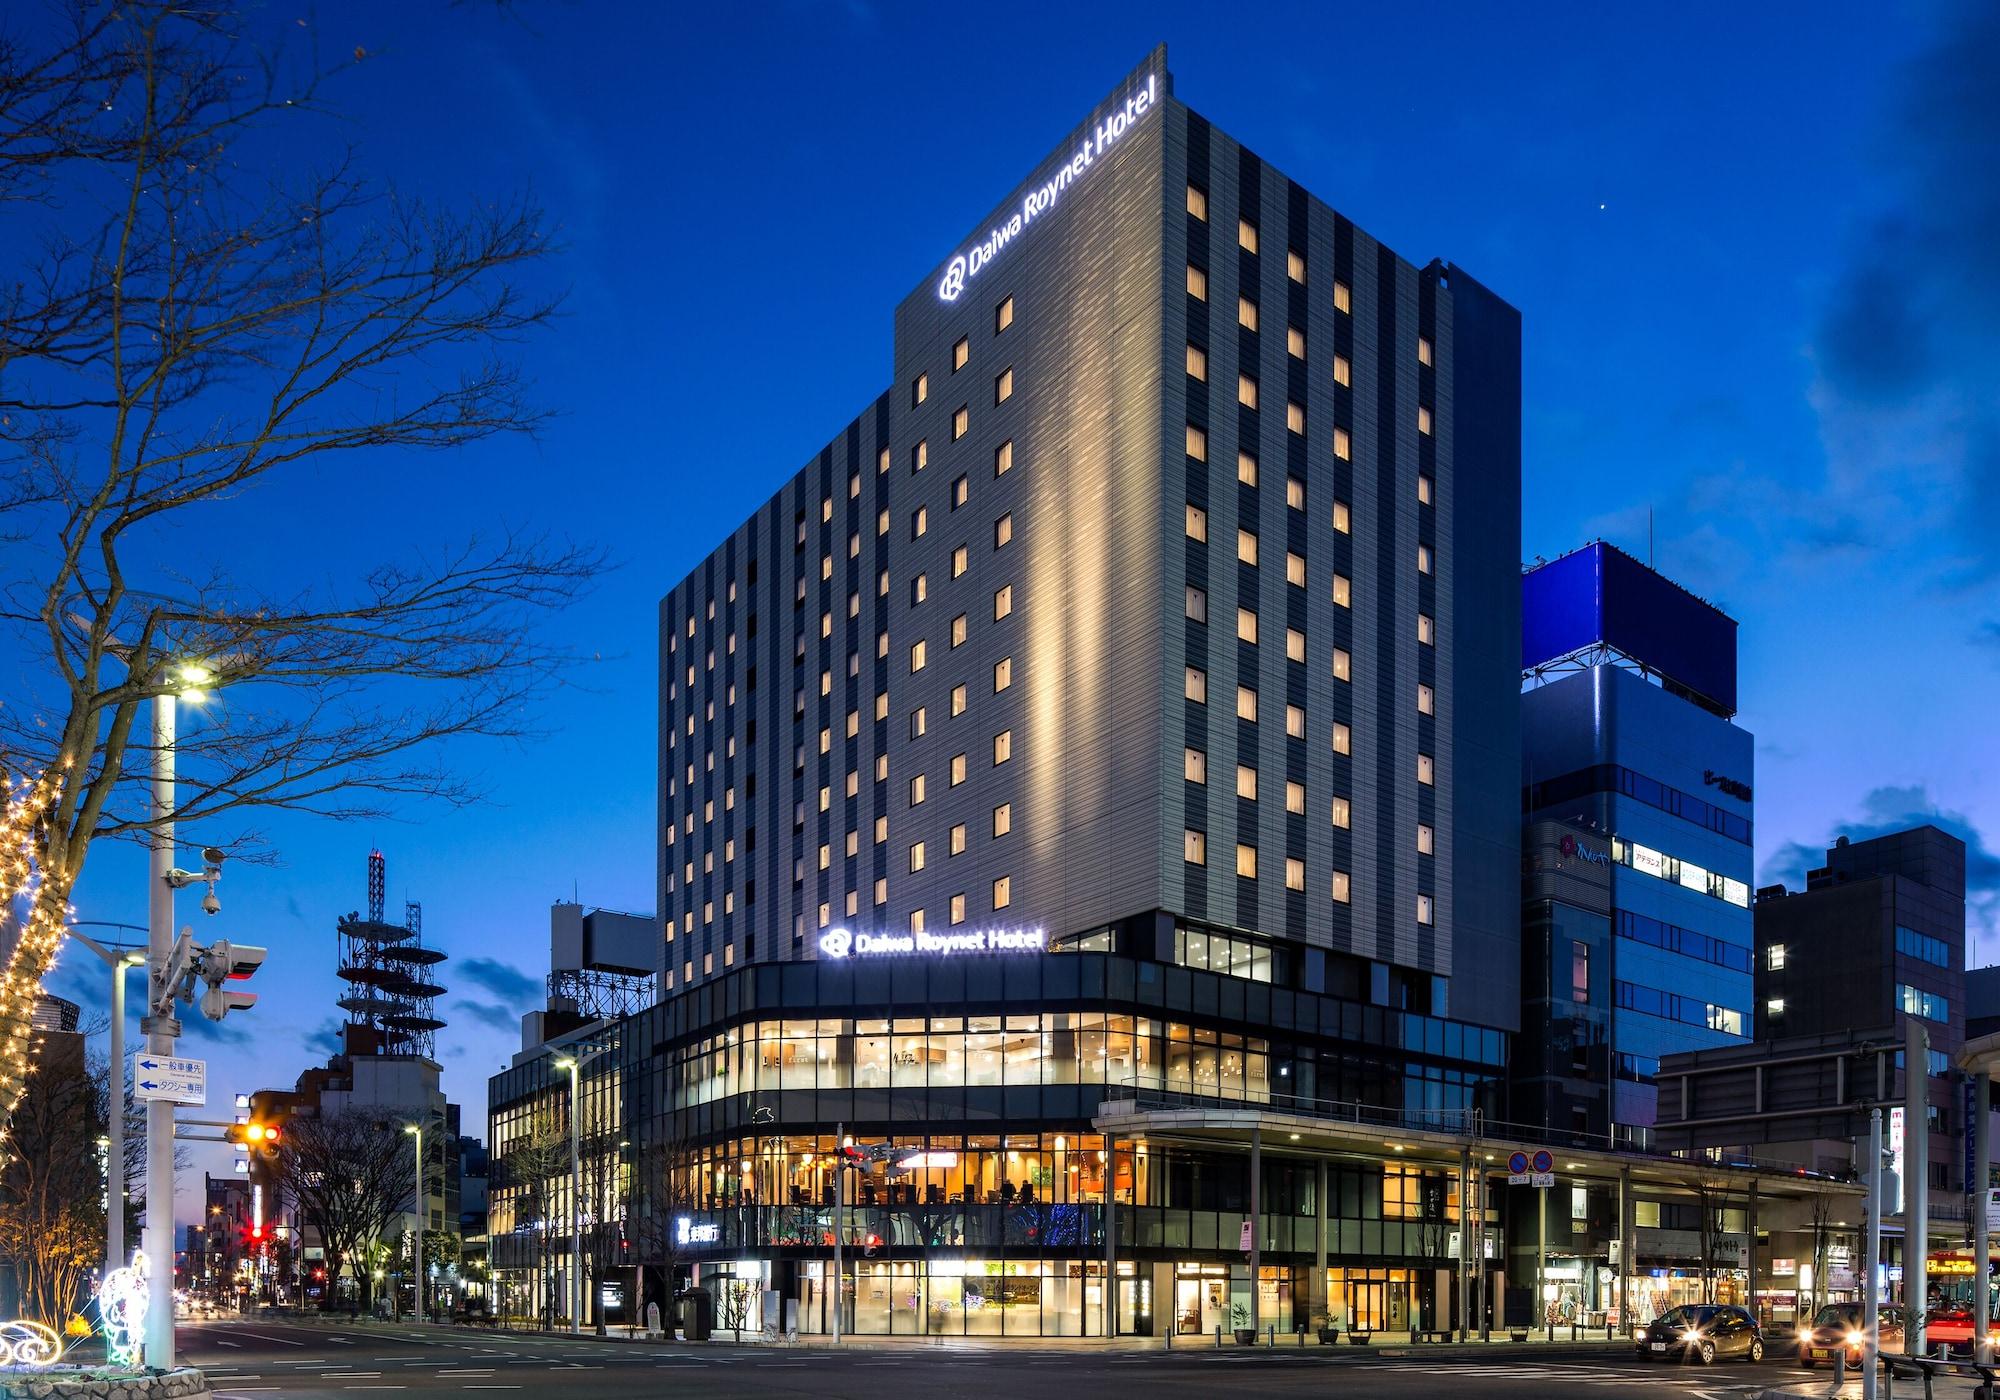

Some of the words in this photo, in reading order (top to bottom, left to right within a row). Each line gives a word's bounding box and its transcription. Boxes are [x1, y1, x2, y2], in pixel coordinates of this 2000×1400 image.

[969, 212, 1022, 277] Daiwa
[1024, 141, 1094, 224] Roynet
[1096, 75, 1156, 155] Hotel
[855, 934, 913, 953] Daiwa
[916, 931, 986, 956] Roynet
[988, 928, 1044, 949] Hotel
[160, 1080, 202, 1095] タクシー専用
